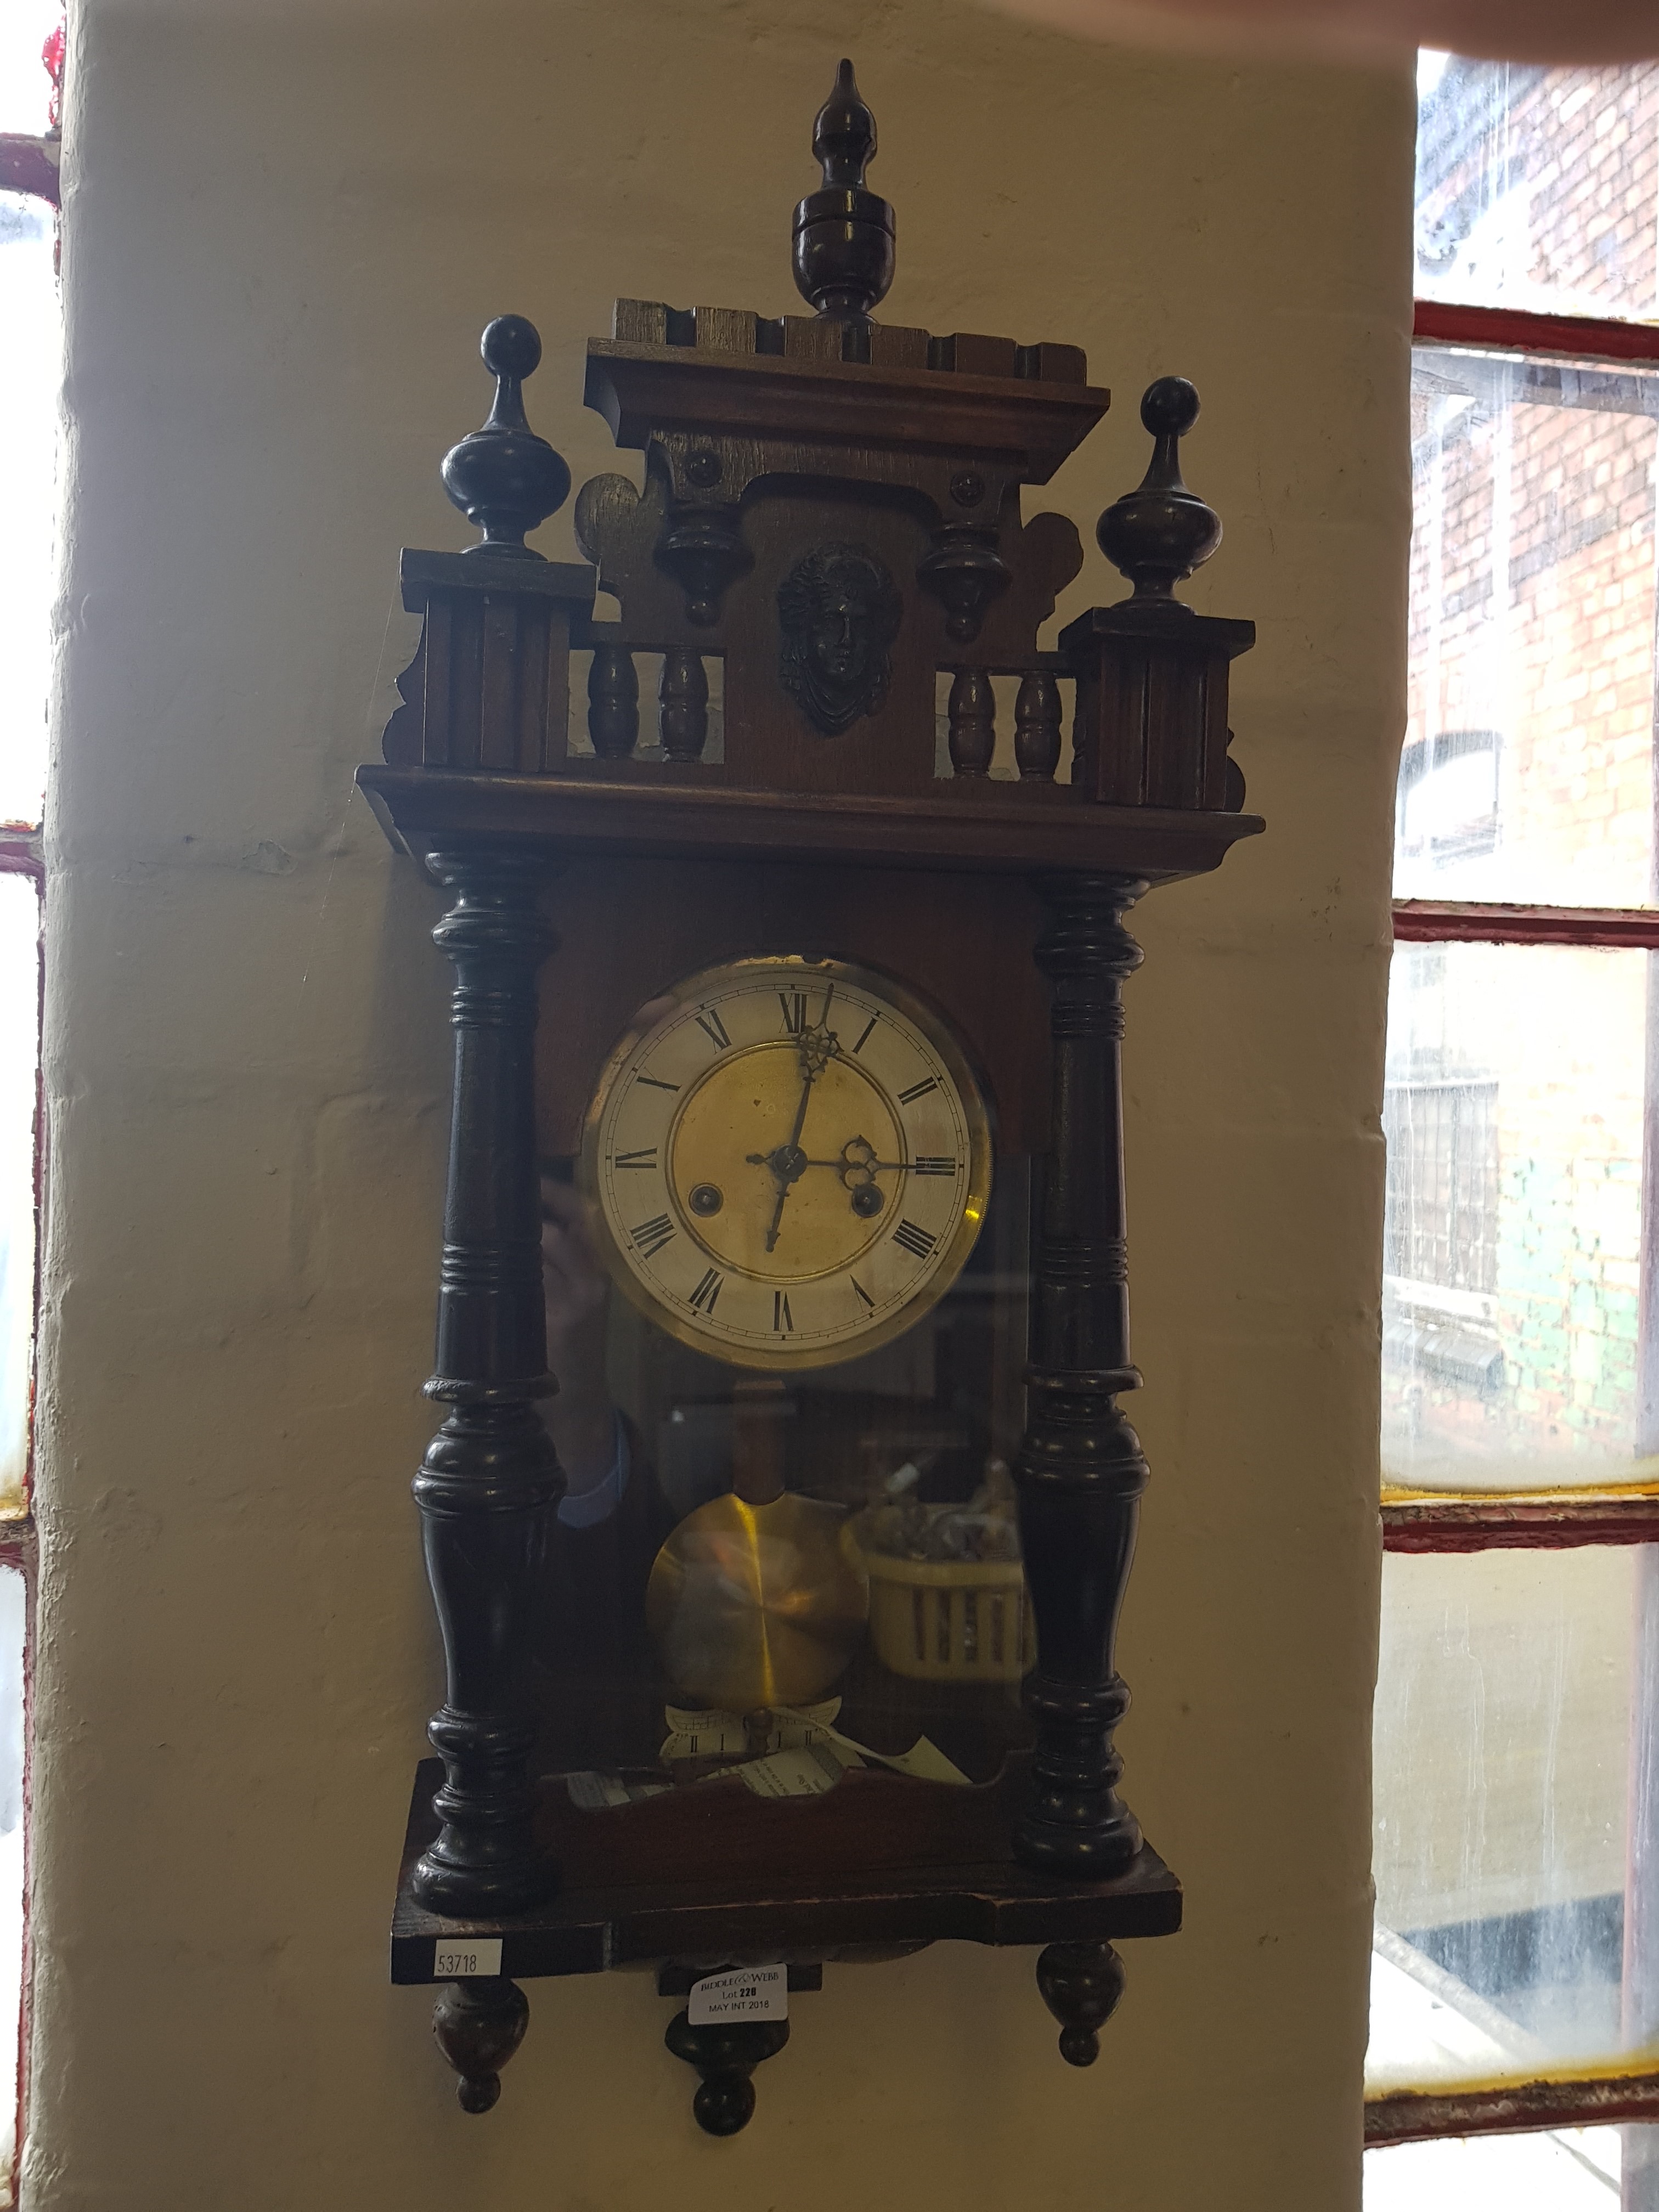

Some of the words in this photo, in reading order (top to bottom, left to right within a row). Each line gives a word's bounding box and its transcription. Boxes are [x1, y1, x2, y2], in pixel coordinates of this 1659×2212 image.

[438, 1954, 477, 1973] 53718
[701, 1978, 735, 1991] BIDDLE
[751, 1972, 779, 1982] WEBB
[709, 2004, 729, 2012] MAY
[731, 2001, 746, 2010] INT
[749, 2000, 769, 2010] 2018
